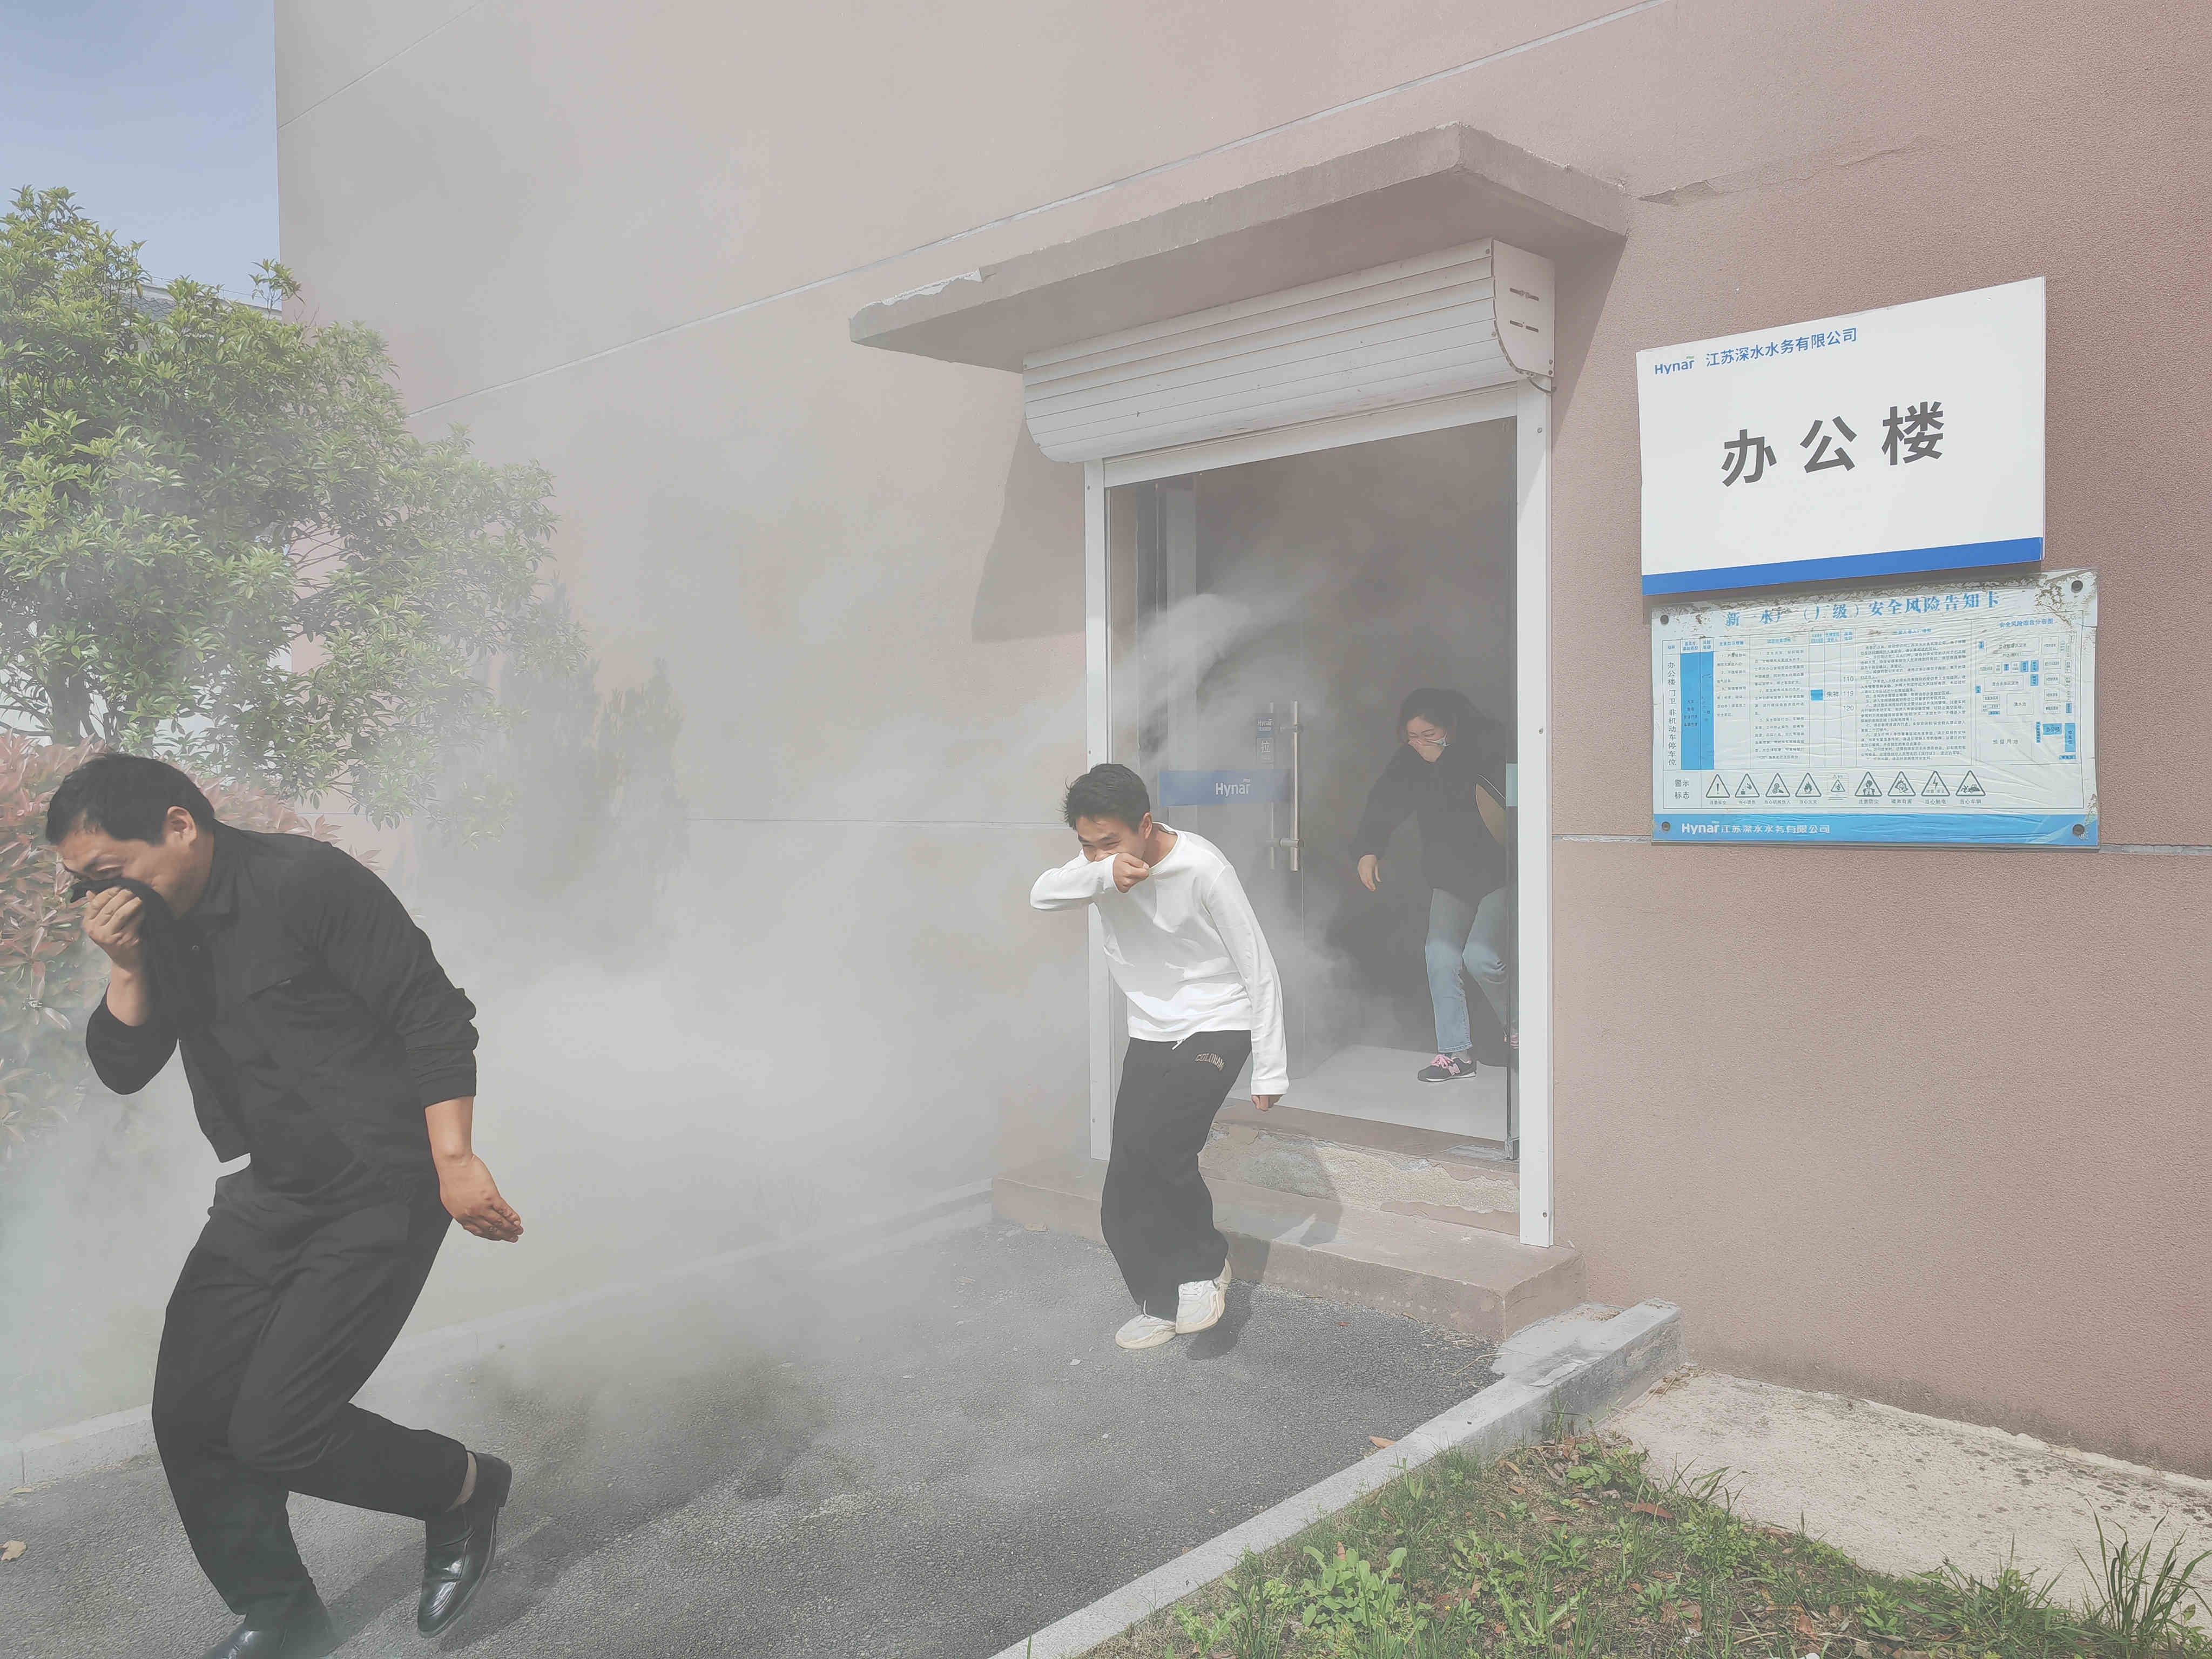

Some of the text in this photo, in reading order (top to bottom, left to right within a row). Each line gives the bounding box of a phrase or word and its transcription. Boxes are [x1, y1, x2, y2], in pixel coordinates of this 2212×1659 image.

[1705, 328, 1857, 367] 江苏深水水务有限公司
[1654, 356, 1695, 374] Hynar
[1721, 401, 1944, 487] 办公楼
[1667, 661, 1676, 685] 办公楼
[1668, 709, 1677, 766] 非机动车停车位
[1215, 779, 1251, 798] Hynar
[1675, 779, 1690, 787] 警示
[1675, 791, 1690, 799] 标志
[1681, 821, 1720, 835] Hynar
[1721, 825, 1831, 834] 江苏深水水务有限公司
